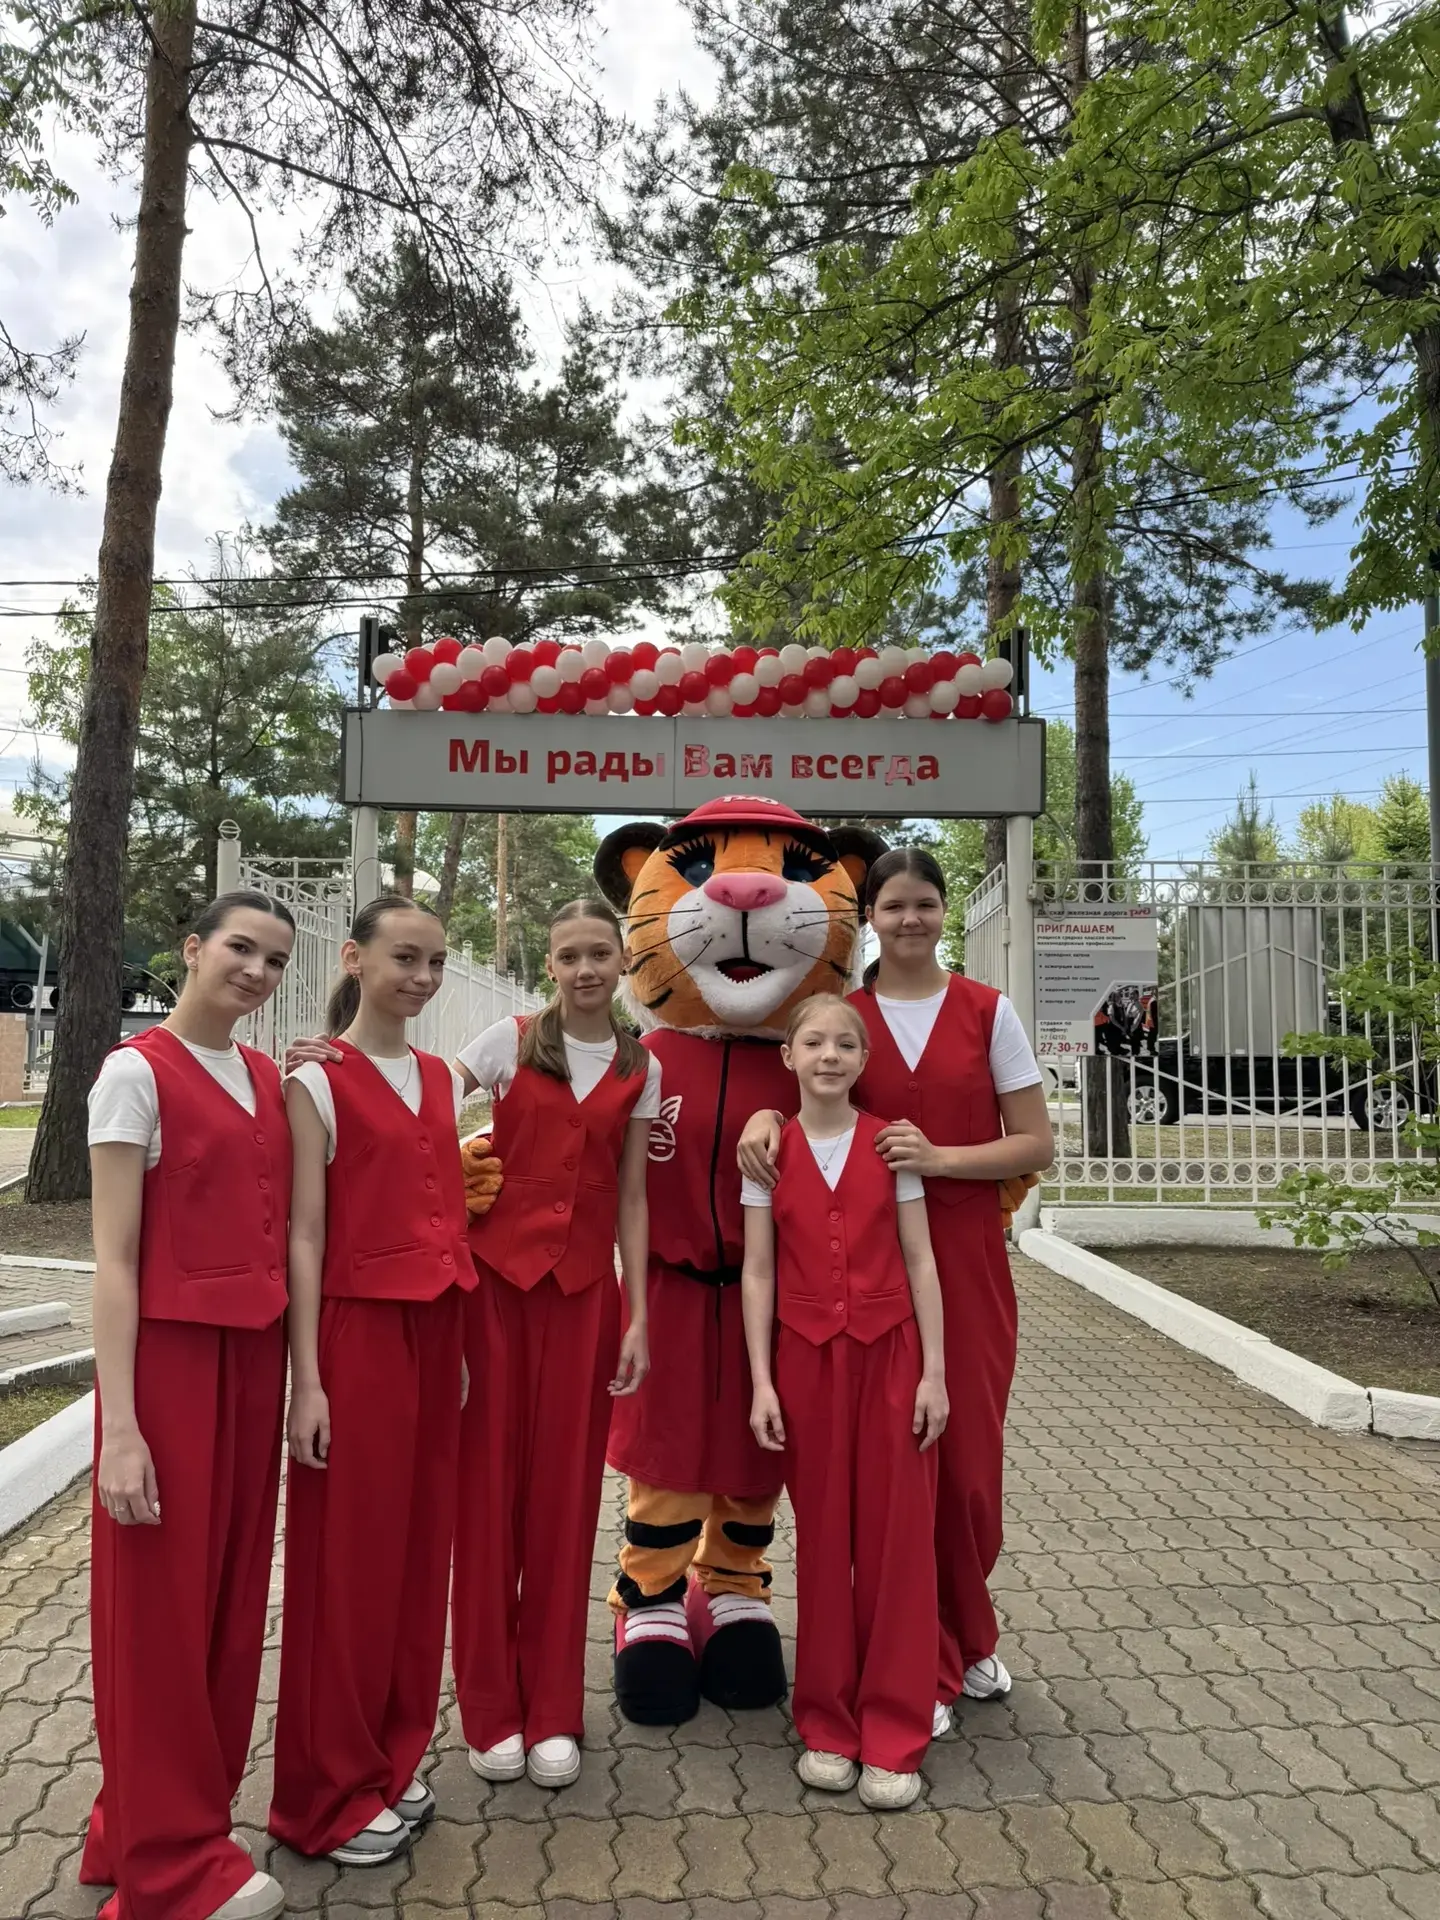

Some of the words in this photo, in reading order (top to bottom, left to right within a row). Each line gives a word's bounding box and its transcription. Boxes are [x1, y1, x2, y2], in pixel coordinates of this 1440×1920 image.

[449, 738, 529, 774] Мы
[547, 750, 666, 784] рады
[684, 743, 774, 779] Вам
[791, 754, 940, 786] всегда
[1103, 909, 1128, 917] дорога
[1036, 924, 1115, 934] ПРИГЛАШАЕМ
[1039, 1042, 1089, 1052] 27-30-79
